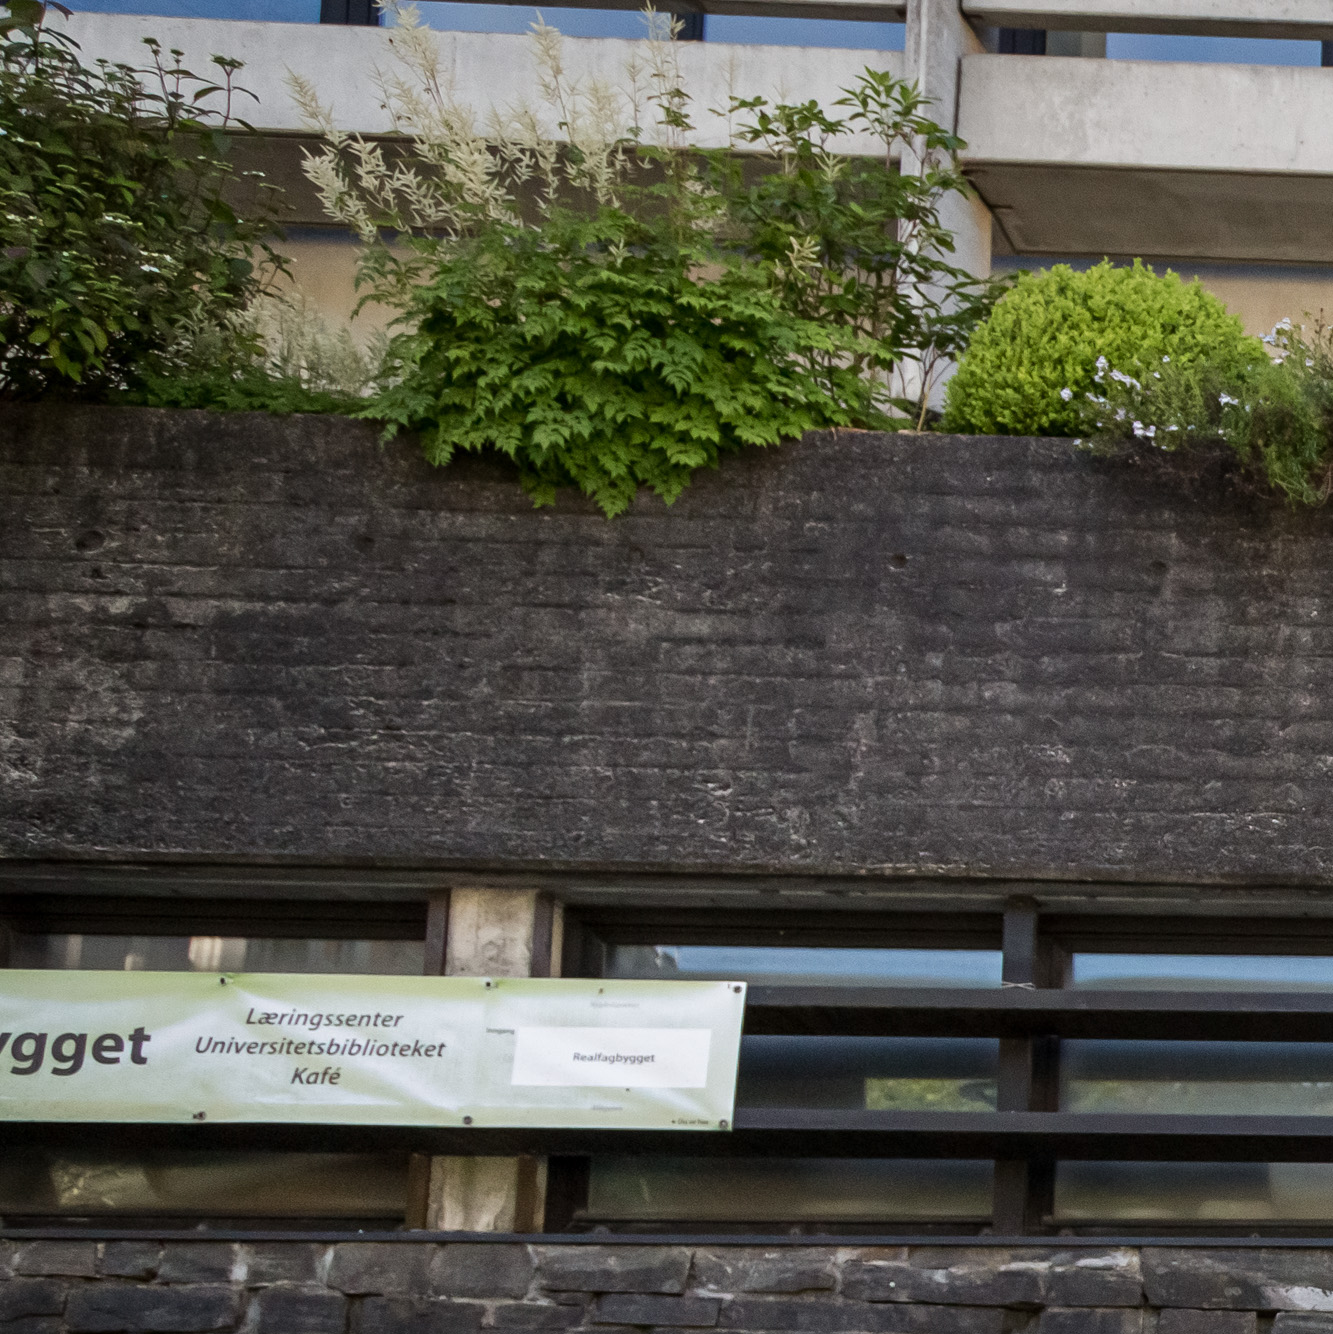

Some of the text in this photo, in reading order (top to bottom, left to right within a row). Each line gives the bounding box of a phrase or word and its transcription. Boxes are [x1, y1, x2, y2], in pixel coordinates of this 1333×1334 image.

[245, 1008, 404, 1031] Læringssenter
[195, 1036, 447, 1057] Universitetsbiblioteket
[573, 1052, 656, 1064] Realfagbygget
[291, 1066, 341, 1085] Kafé
